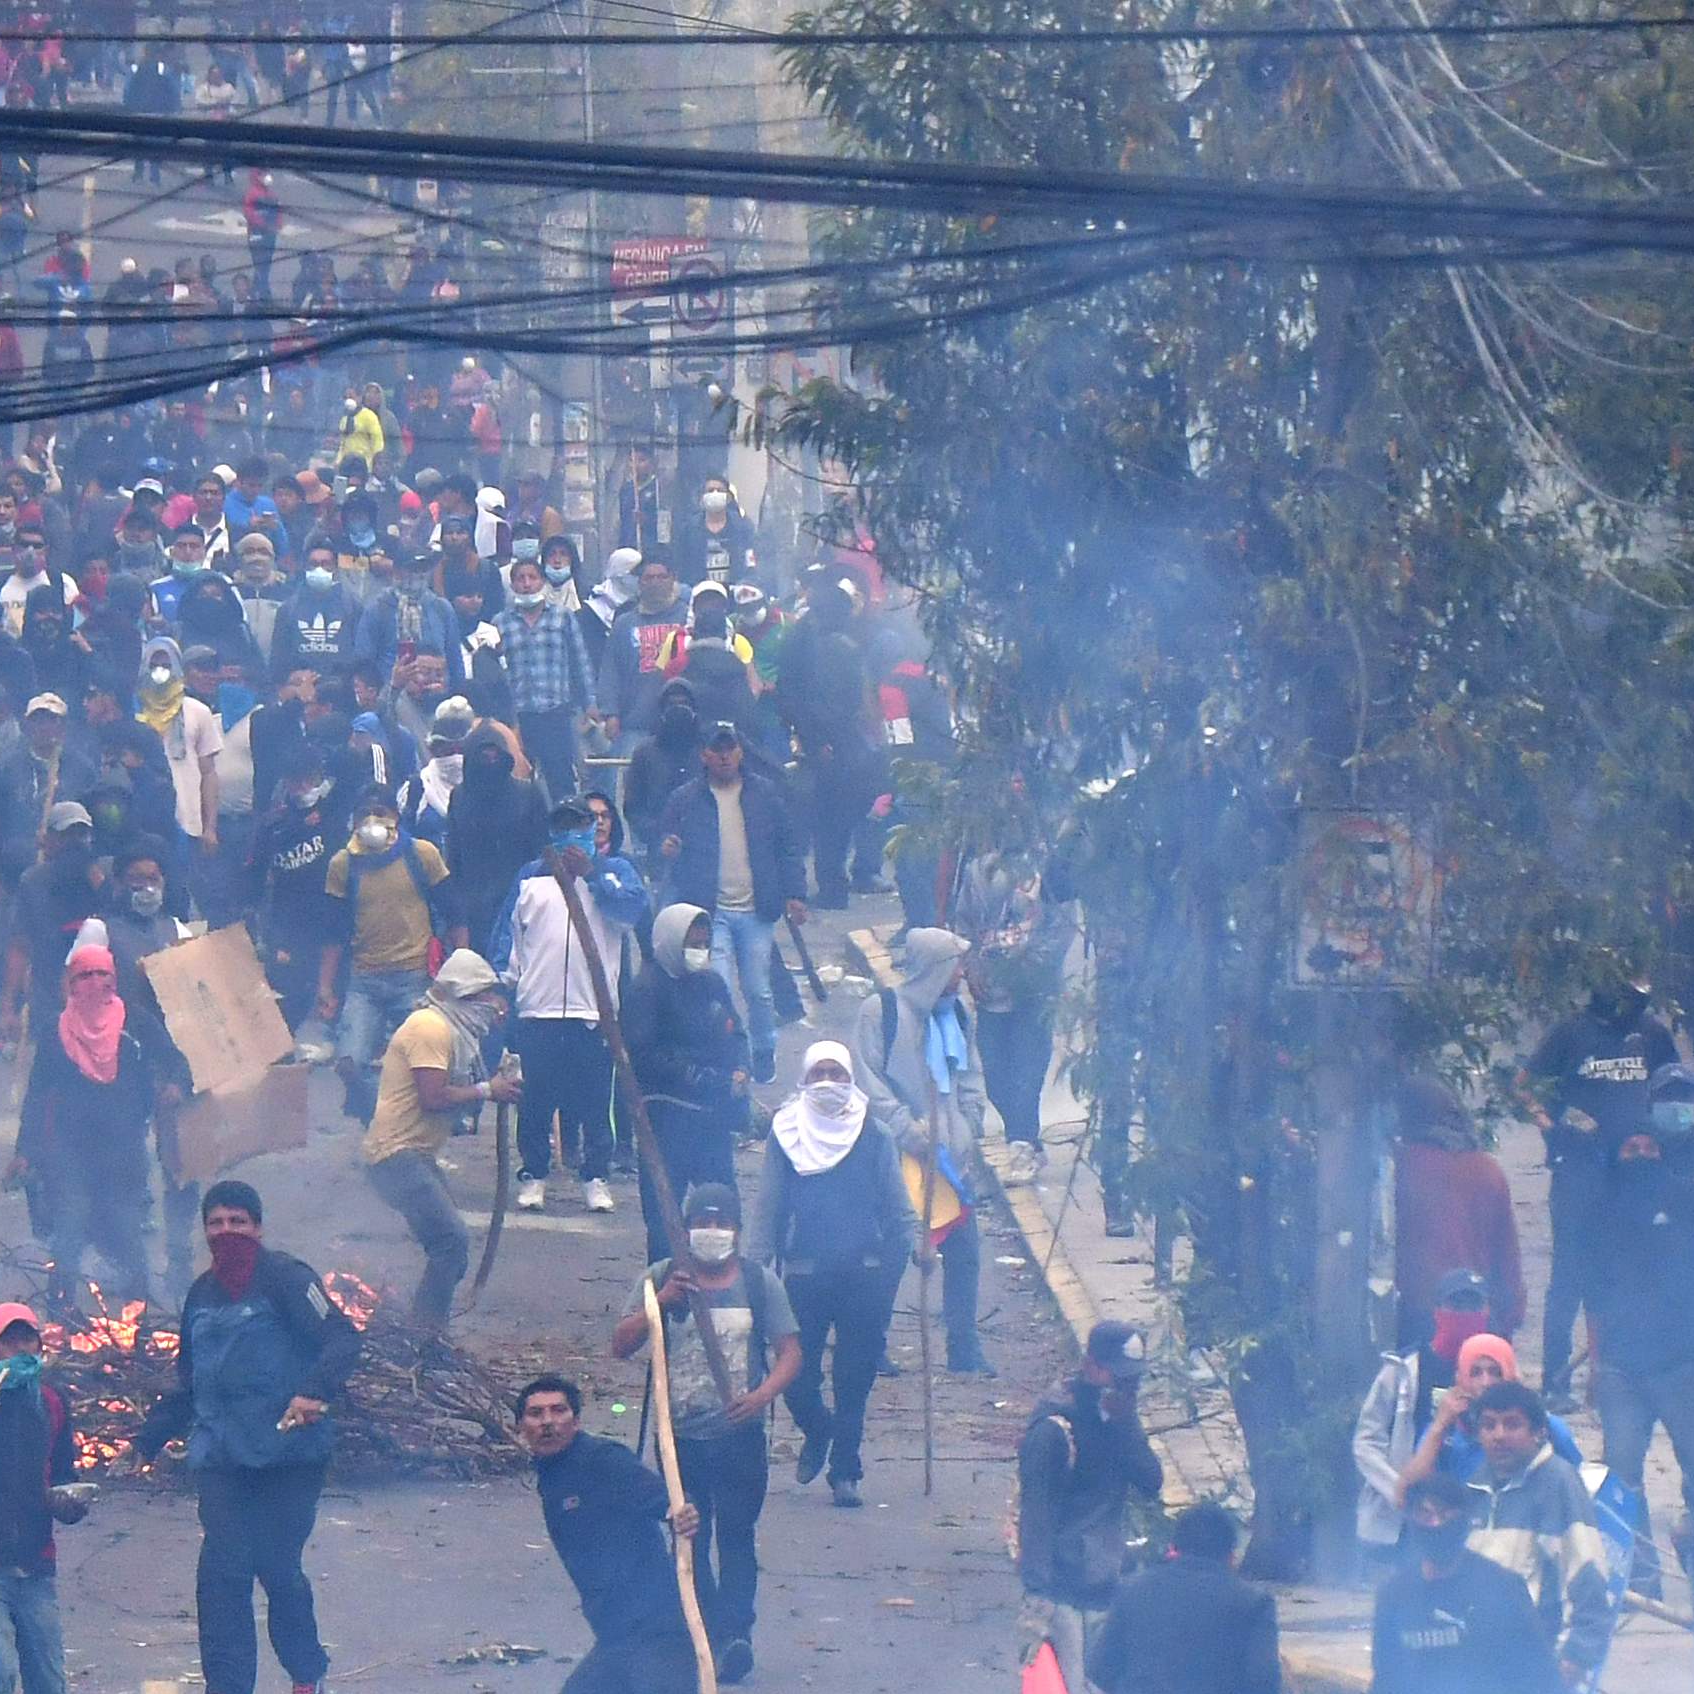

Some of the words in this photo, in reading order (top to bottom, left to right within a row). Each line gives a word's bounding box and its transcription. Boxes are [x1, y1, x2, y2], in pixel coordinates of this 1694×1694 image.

[625, 270, 670, 287] GENER
[297, 640, 339, 653] adidas
[273, 835, 325, 868] QATAR
